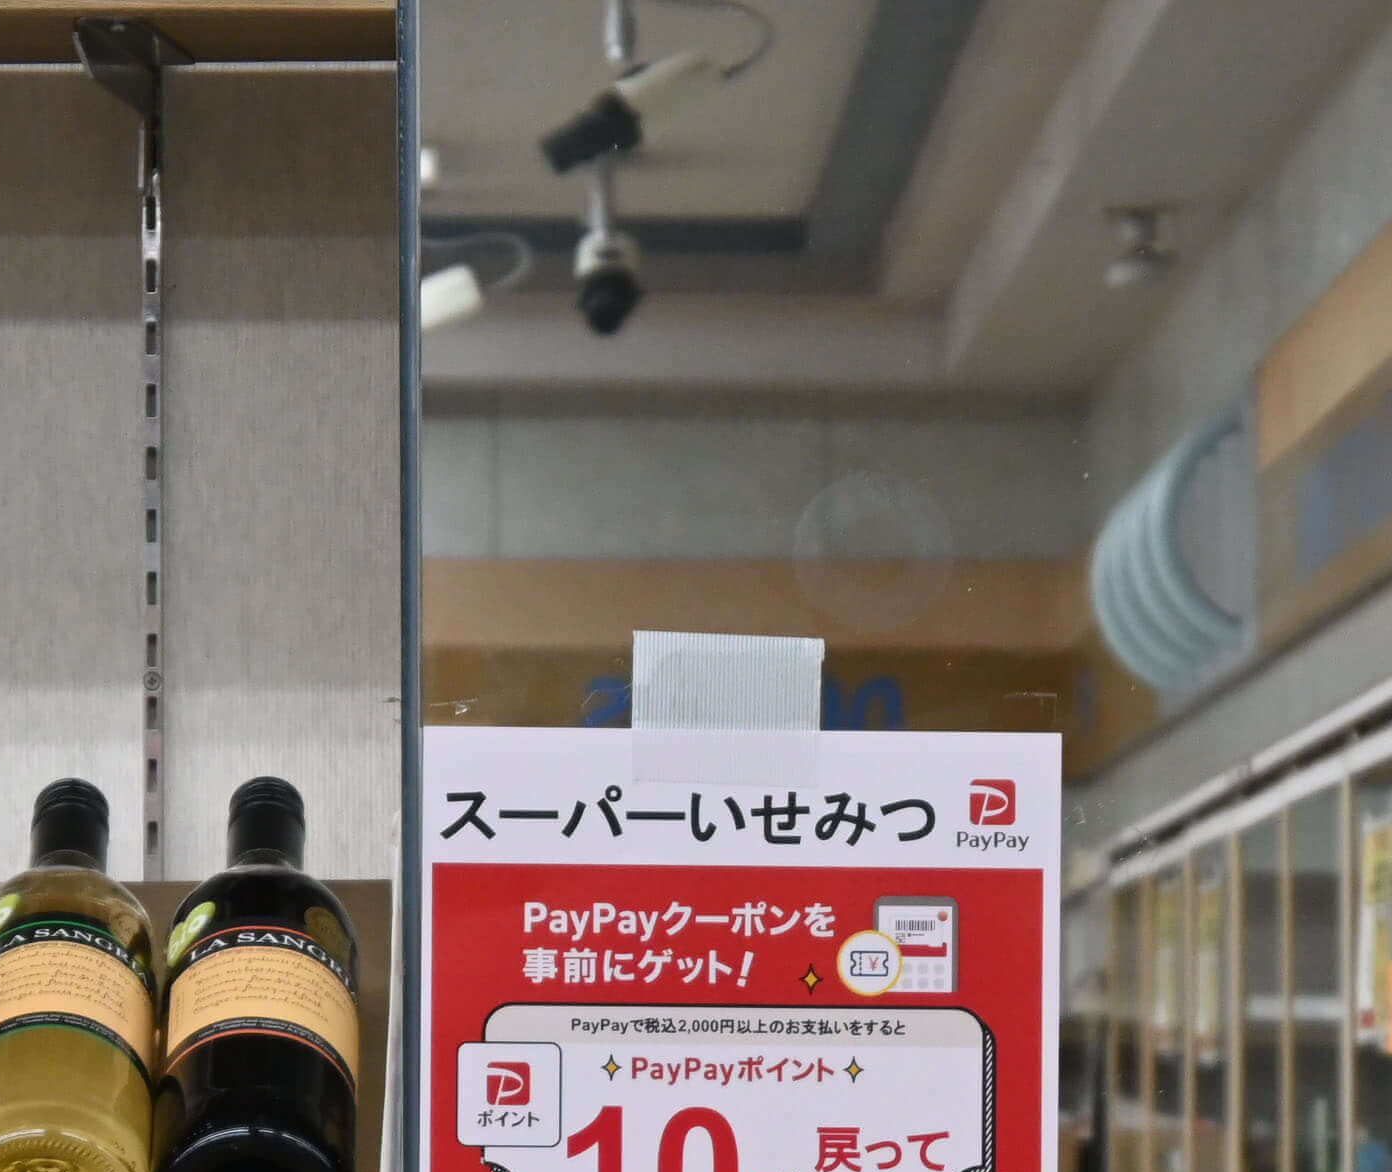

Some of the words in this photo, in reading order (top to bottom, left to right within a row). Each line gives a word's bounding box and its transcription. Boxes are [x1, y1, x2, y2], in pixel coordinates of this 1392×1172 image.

[440, 786, 937, 847] スーパーいせみつ
[956, 831, 1029, 852] PayPay
[523, 901, 836, 941] PayPayクーポンを
[189, 938, 227, 961] LA
[570, 1016, 906, 1036] PayPayで税込2,000円以上のお支払いをすると
[631, 1056, 835, 1086] PayPayポイント
[477, 1110, 541, 1128] ポイント
[814, 1127, 951, 1172] 戻って
